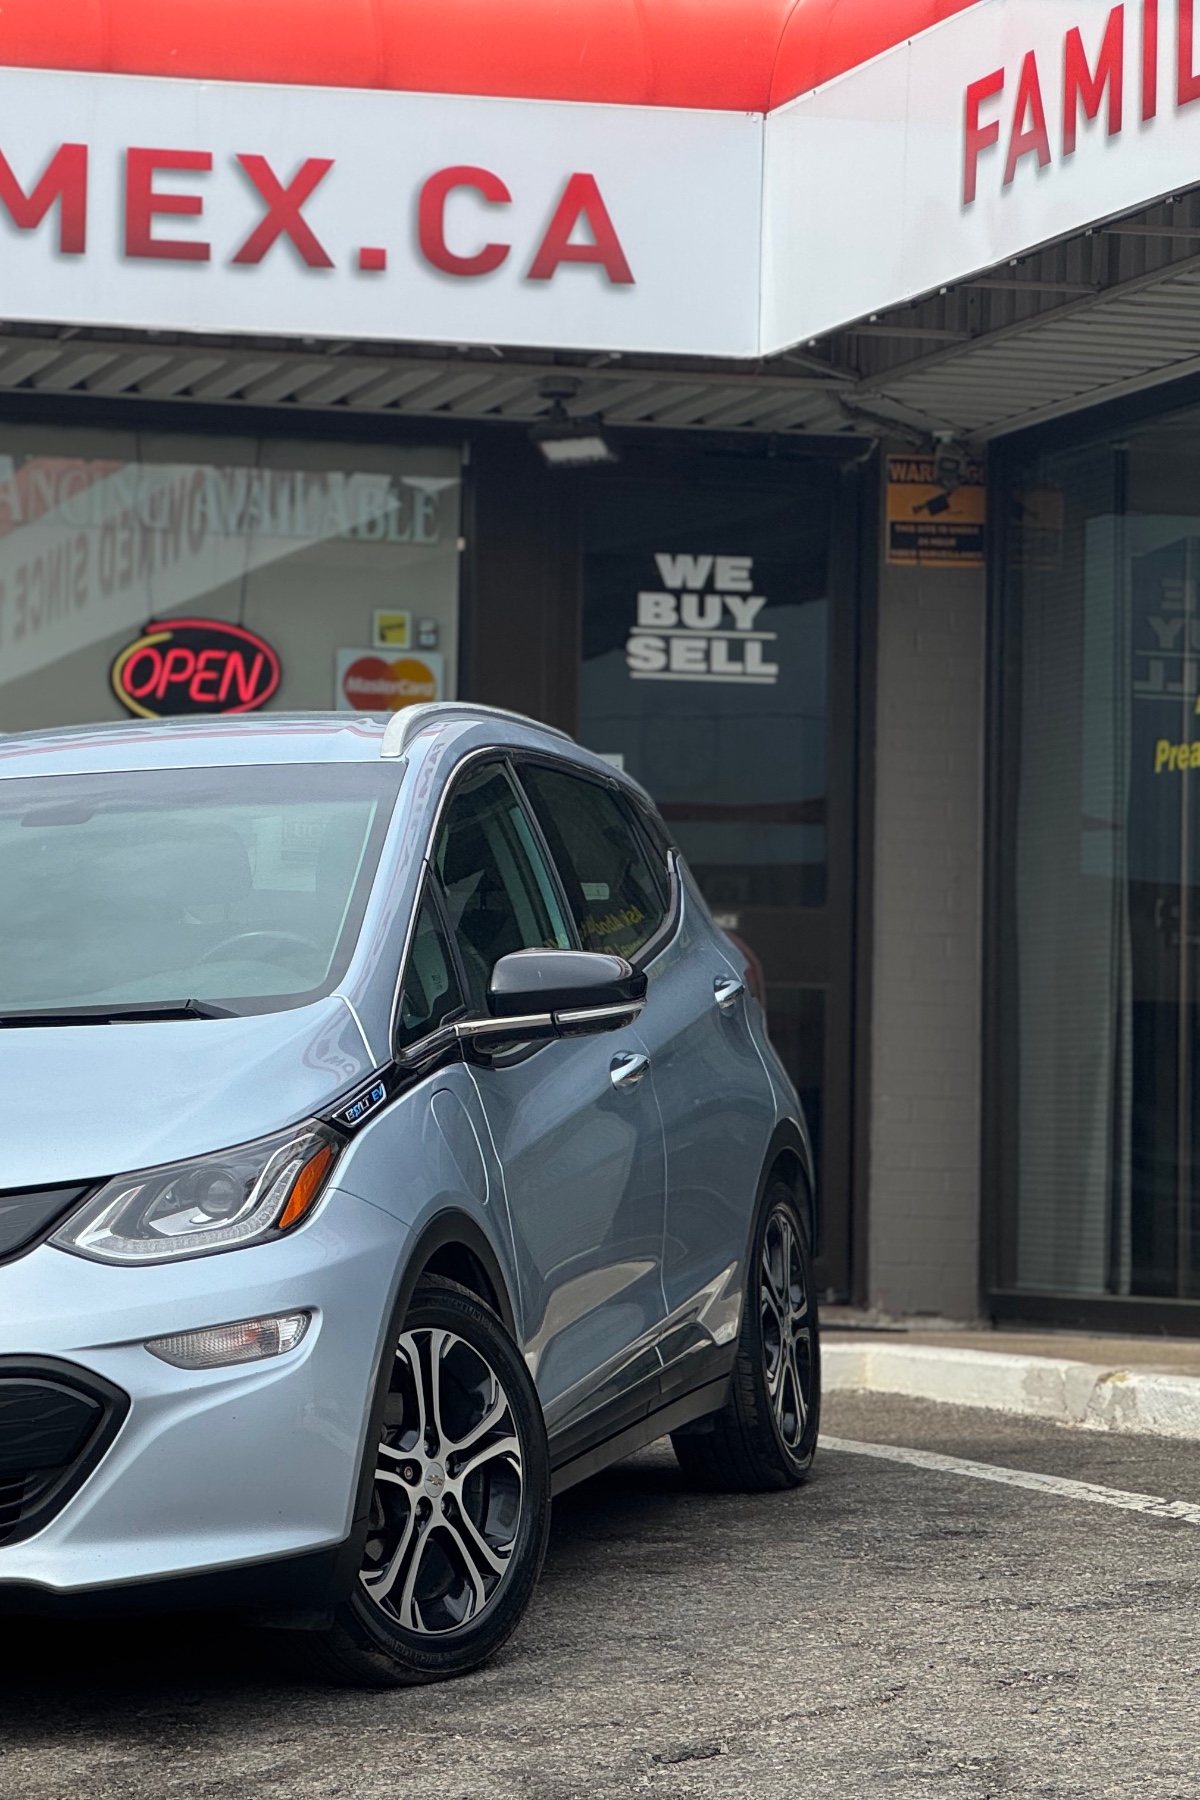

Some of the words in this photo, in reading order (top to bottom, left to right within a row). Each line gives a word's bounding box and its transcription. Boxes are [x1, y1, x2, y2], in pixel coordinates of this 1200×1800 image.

[889, 462, 984, 482] WARG!
[654, 553, 753, 591] WE
[637, 591, 767, 630] BUY
[625, 635, 779, 675] SELL
[121, 648, 264, 702] OPEN
